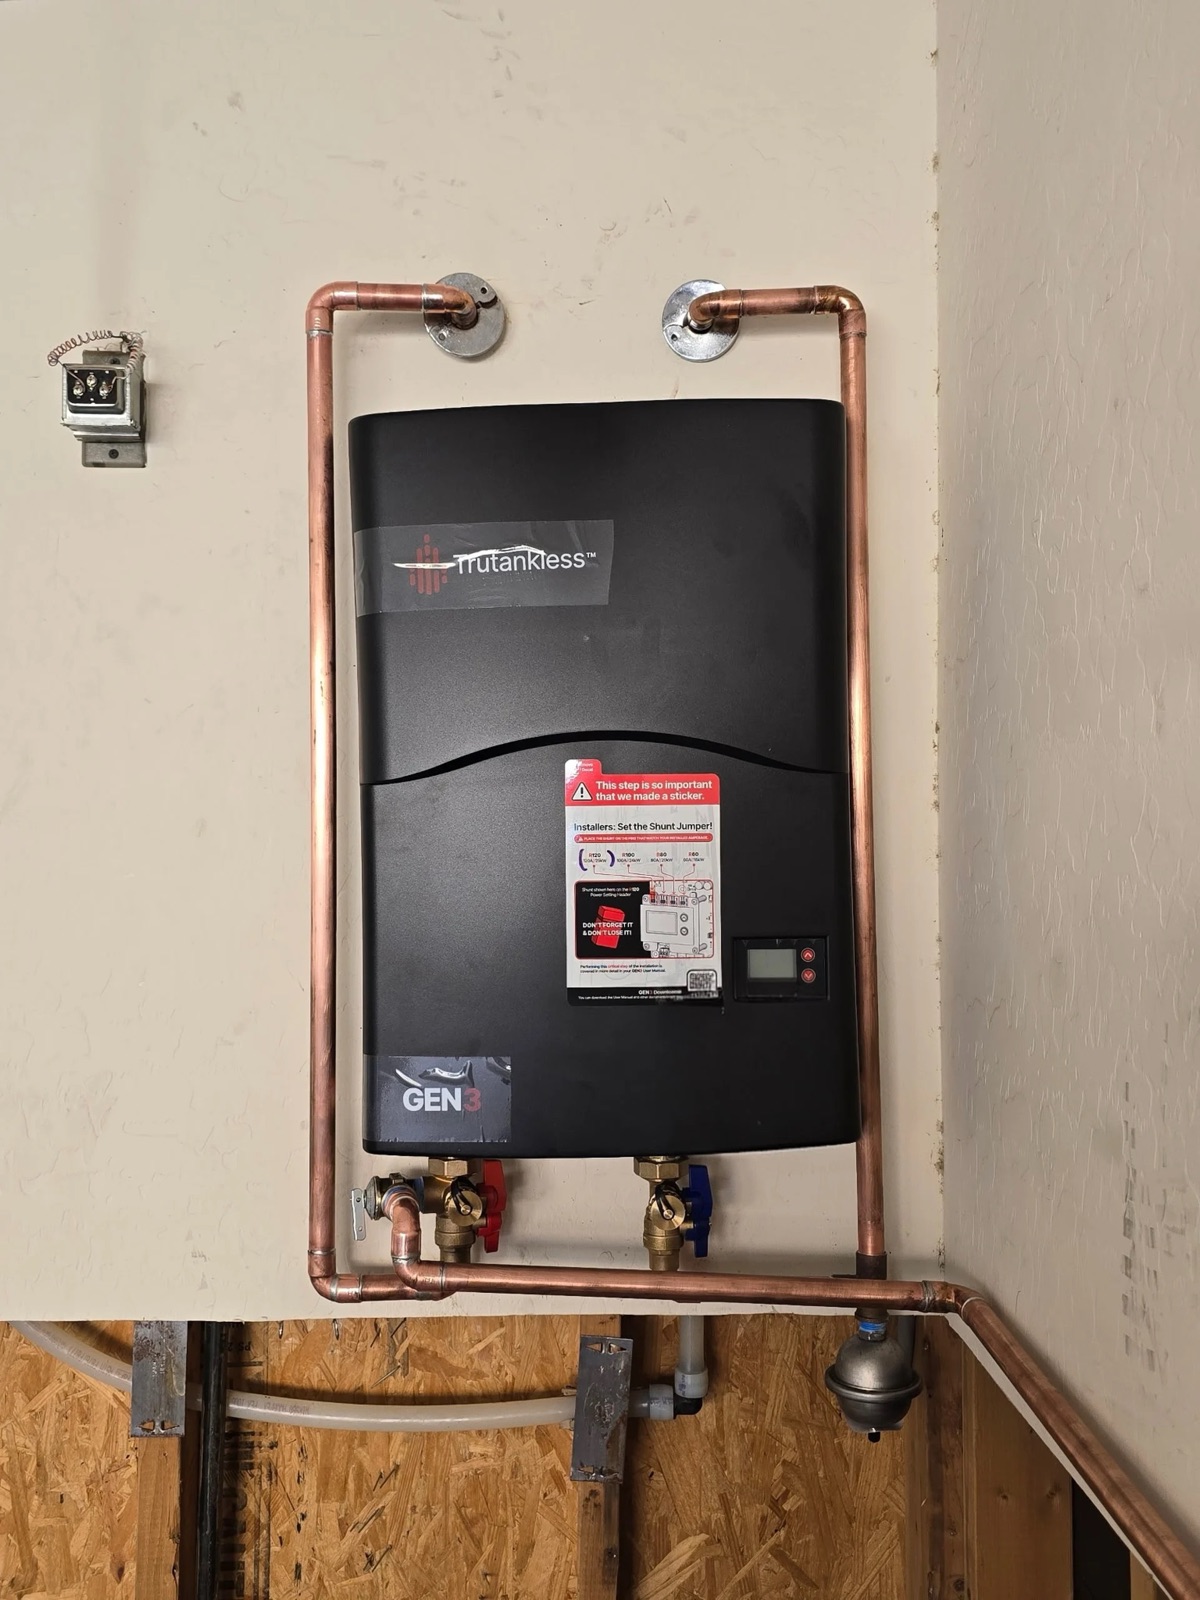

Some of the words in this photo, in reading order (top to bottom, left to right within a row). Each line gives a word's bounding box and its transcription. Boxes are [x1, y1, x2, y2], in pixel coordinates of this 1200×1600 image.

[595, 780, 617, 790] This
[618, 780, 640, 791] step
[641, 780, 650, 790] is
[651, 782, 663, 790] so
[665, 780, 713, 791] important
[595, 792, 616, 801] that
[633, 791, 660, 800] made
[670, 791, 705, 800] sticker.
[573, 822, 616, 831] Installers:
[617, 822, 632, 831] Set
[633, 822, 648, 831] the
[649, 822, 675, 830] Shunt
[677, 821, 713, 832] Jumper!
[402, 1087, 482, 1112] GEN3
